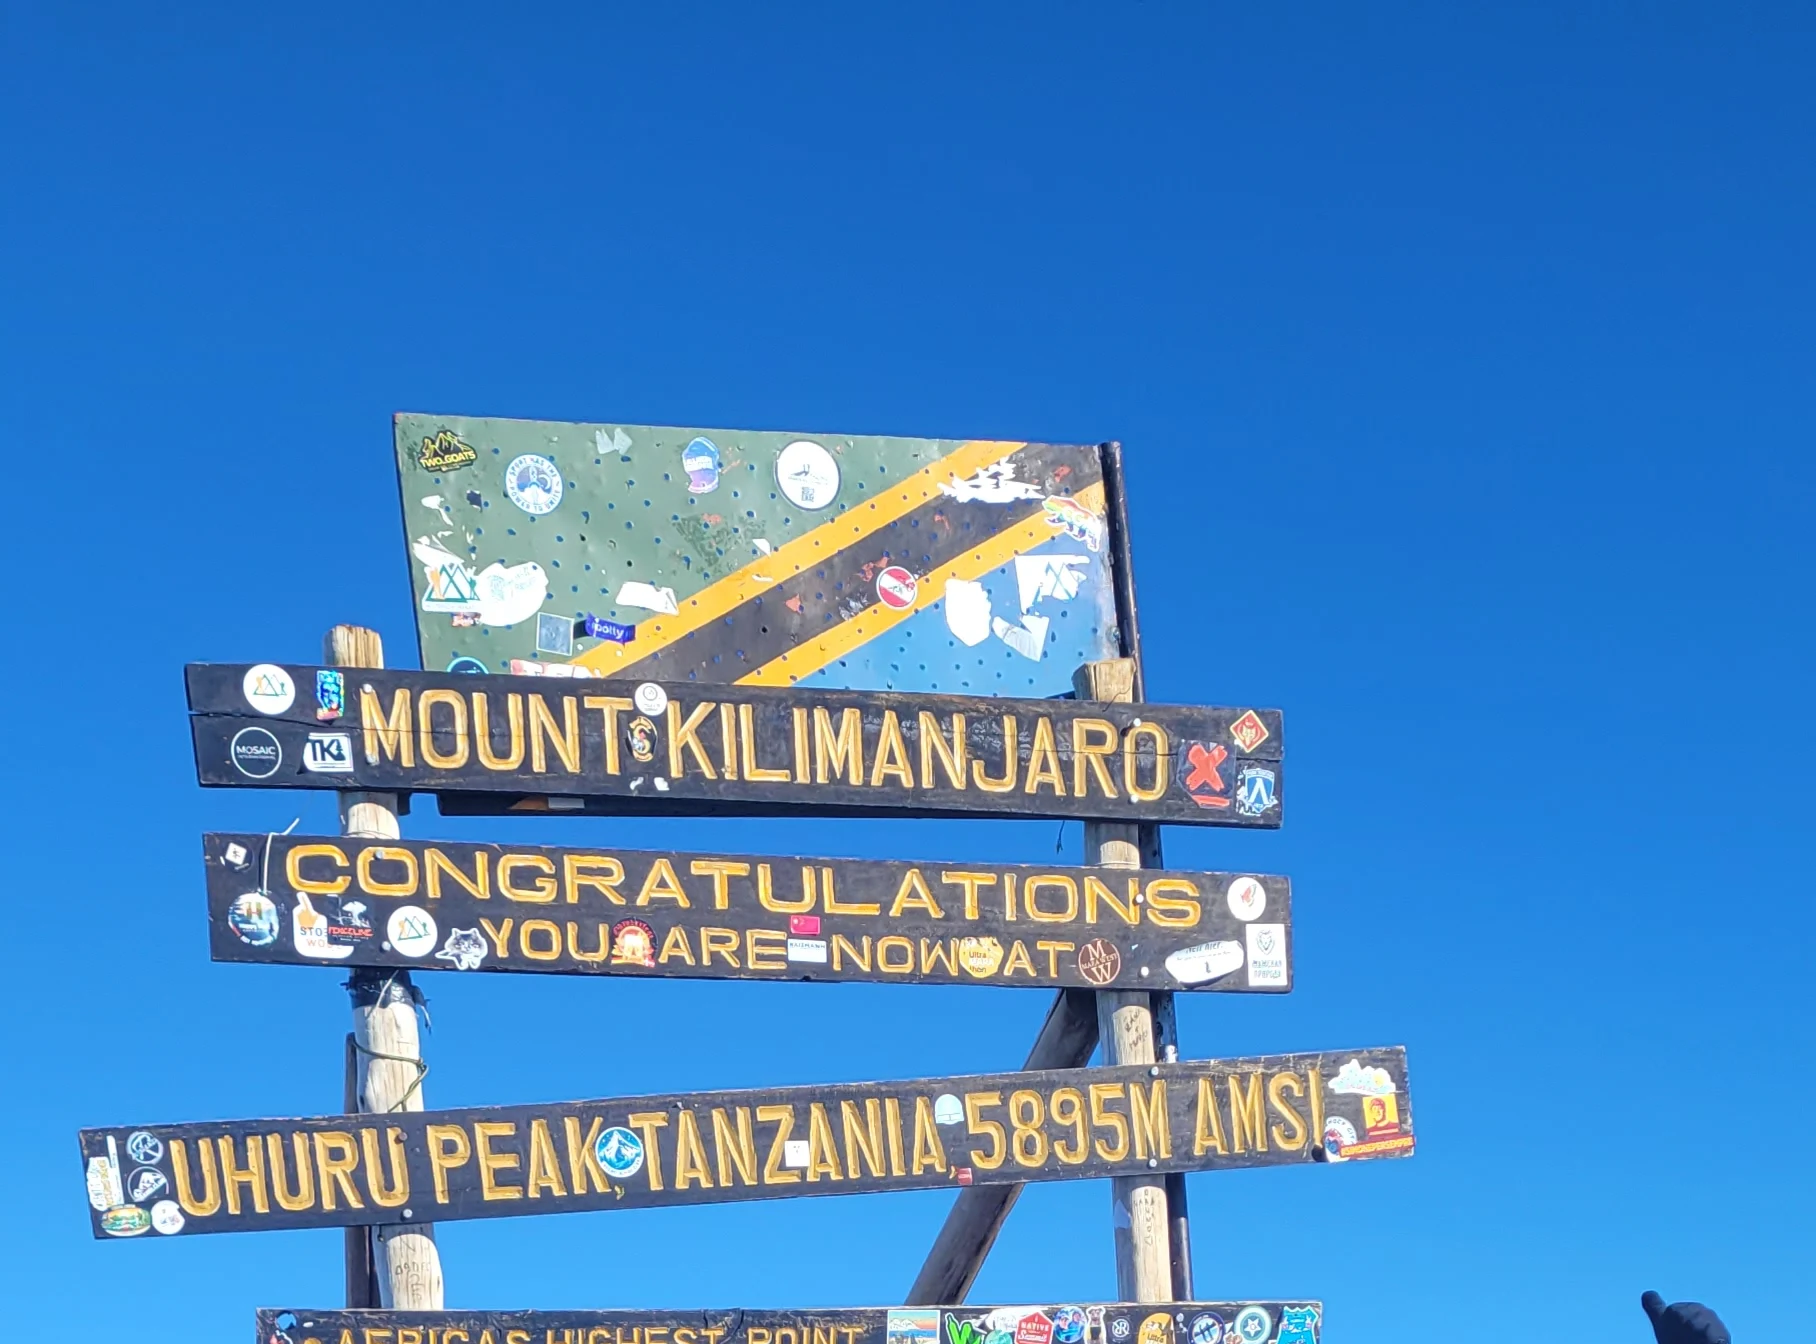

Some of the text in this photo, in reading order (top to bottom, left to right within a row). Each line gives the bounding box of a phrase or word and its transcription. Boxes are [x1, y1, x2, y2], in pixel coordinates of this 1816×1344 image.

[420, 451, 476, 468] TWO GOATS
[509, 486, 530, 509] POWER
[236, 745, 276, 755] MOSAIC
[360, 686, 1170, 801] MOUNT KILIMANJARO
[285, 844, 1201, 927] CONGRATULATIONS
[479, 917, 1076, 978] YOU ARE NOW AT
[169, 1126, 410, 1217] UHURU
[965, 1079, 1173, 1170] 5895M
[1020, 1321, 1050, 1332] NATIVE
